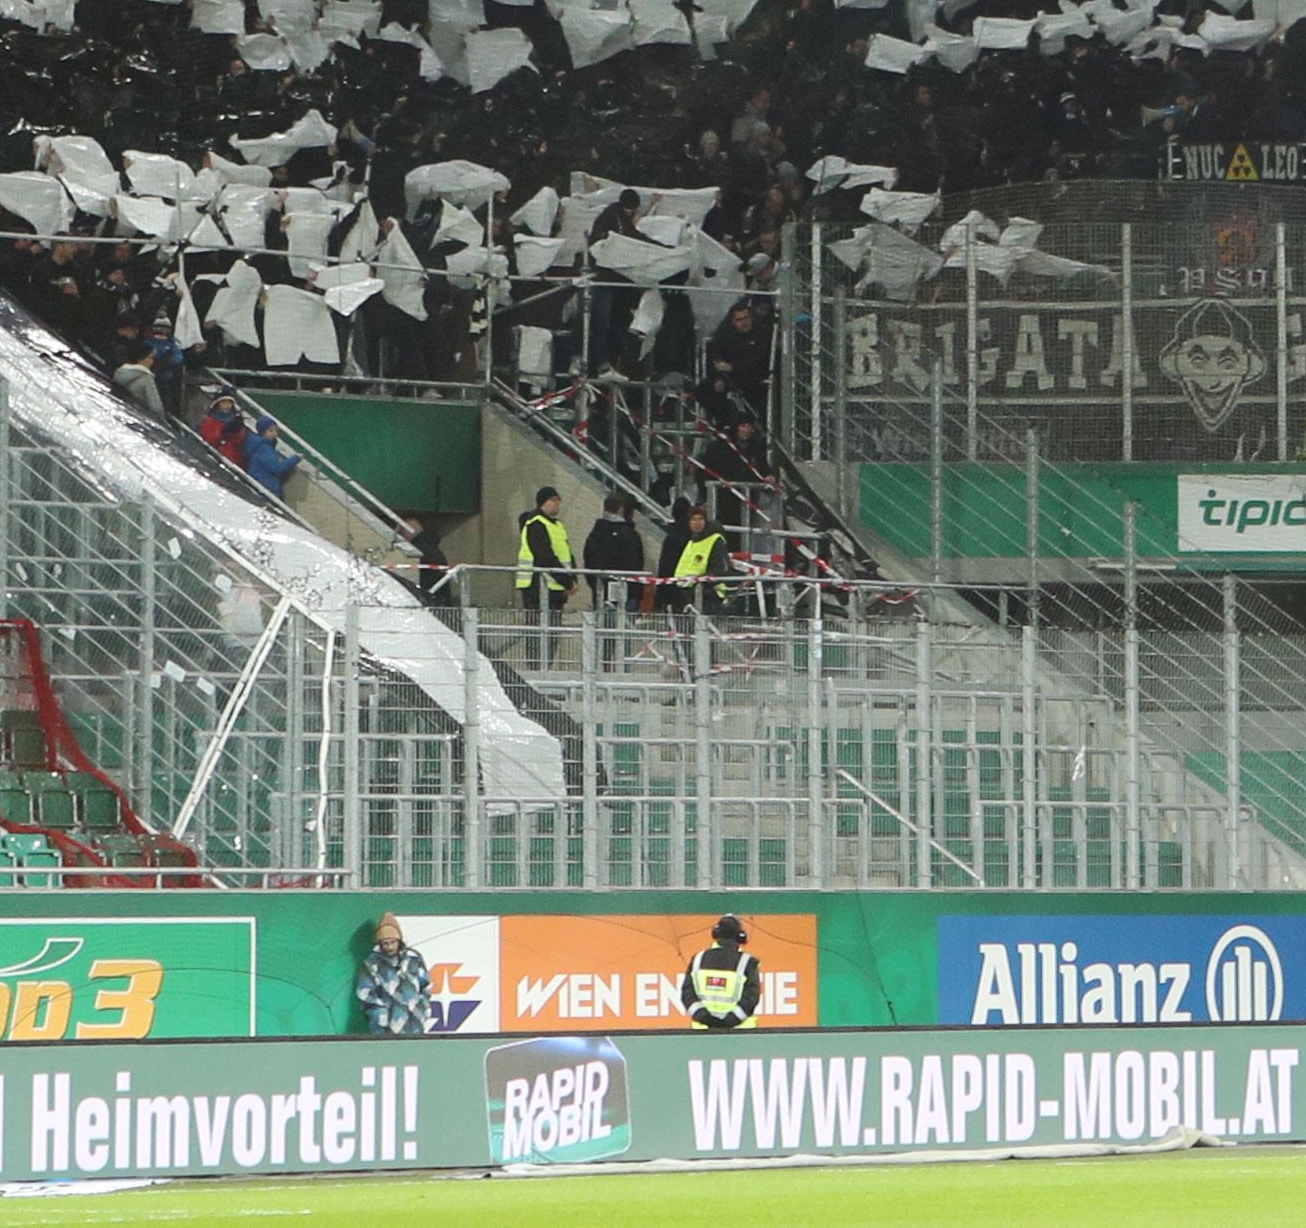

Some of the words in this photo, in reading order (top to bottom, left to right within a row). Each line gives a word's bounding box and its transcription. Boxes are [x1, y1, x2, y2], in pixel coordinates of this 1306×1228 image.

[844, 313, 1149, 391] BRIGATA
[516, 973, 621, 1018] WIEN
[636, 971, 798, 1017] ENIE
[971, 941, 1192, 1024] Allianz
[31, 1065, 419, 1172] Heimvorteil!
[505, 1061, 609, 1119] RAPID
[688, 1048, 1300, 1151] WWW.RAPID-MOBIL.AT
[502, 1099, 612, 1160] MOBIL
